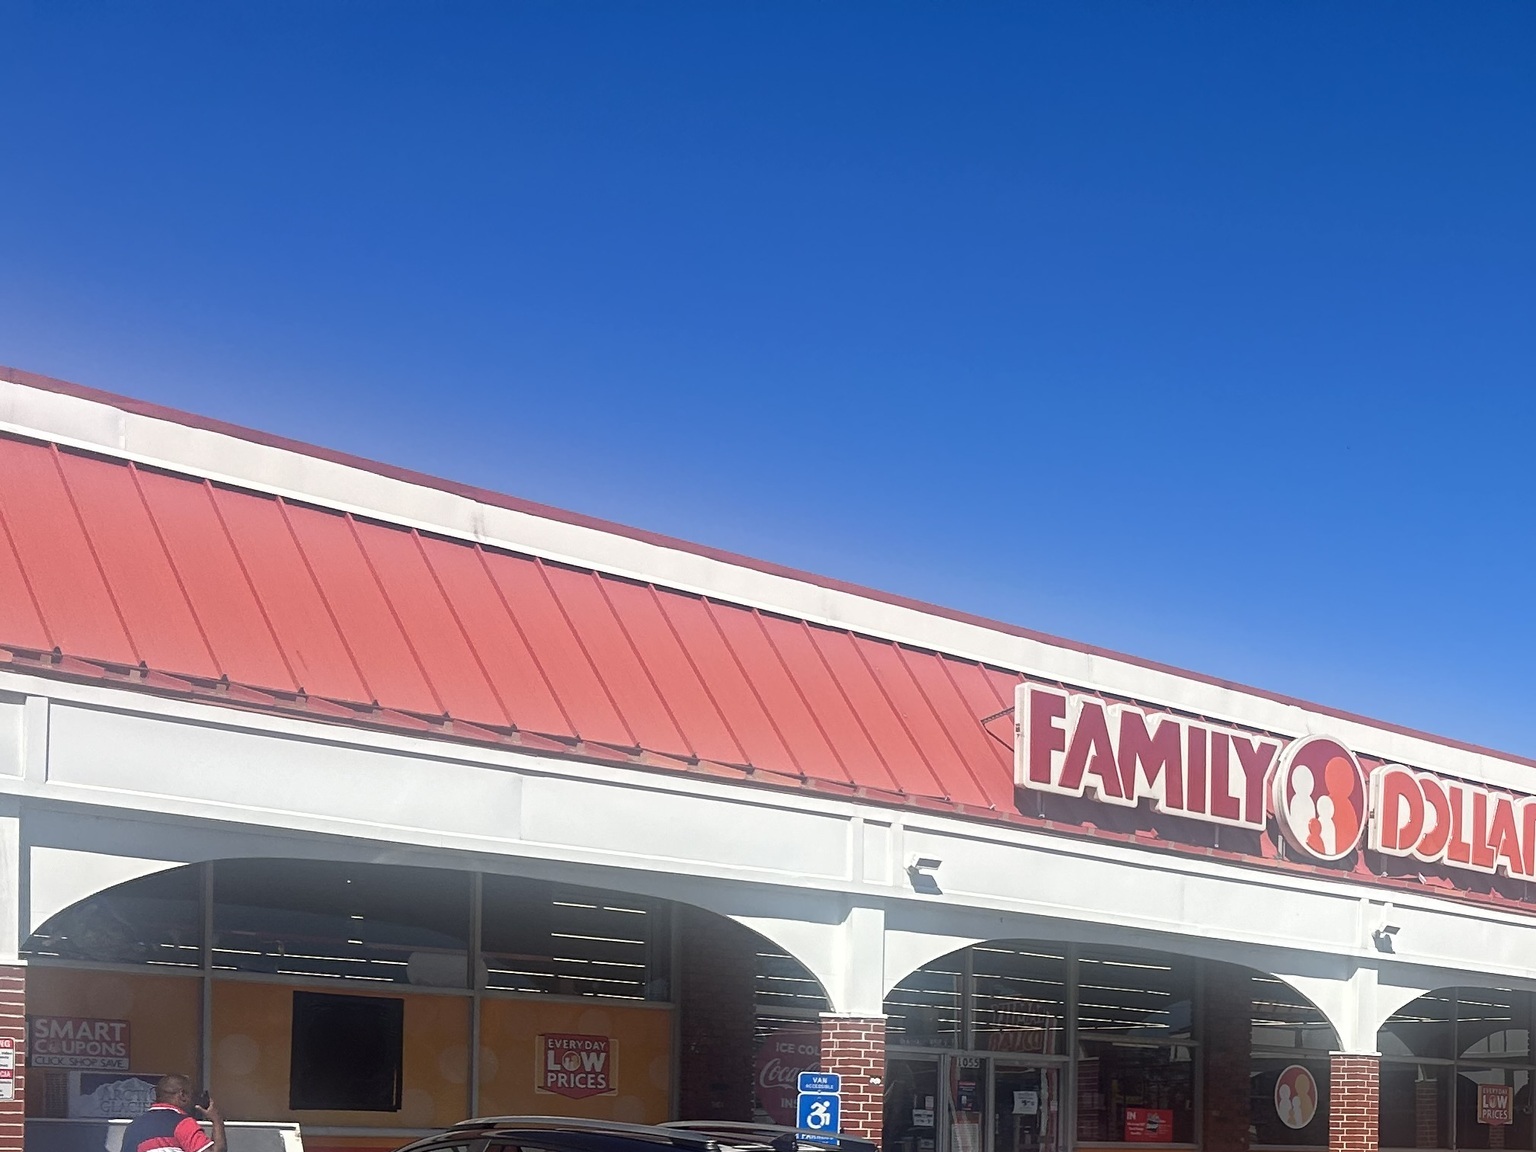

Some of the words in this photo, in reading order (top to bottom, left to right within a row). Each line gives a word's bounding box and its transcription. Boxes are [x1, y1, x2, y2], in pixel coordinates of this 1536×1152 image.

[1028, 689, 1281, 827] FAMILY
[34, 1019, 127, 1041] SMART
[34, 1038, 126, 1056] COUPONS
[548, 1039, 606, 1050] EVERYDAY
[776, 1042, 795, 1054] ICE
[798, 1045, 821, 1056] COL
[547, 1050, 607, 1072] LOW
[958, 1057, 979, 1068] 1055
[547, 1072, 607, 1089] PRICES
[781, 1097, 798, 1109] INS
[1483, 1094, 1508, 1109] LOW
[1482, 1109, 1508, 1120] PRICES
